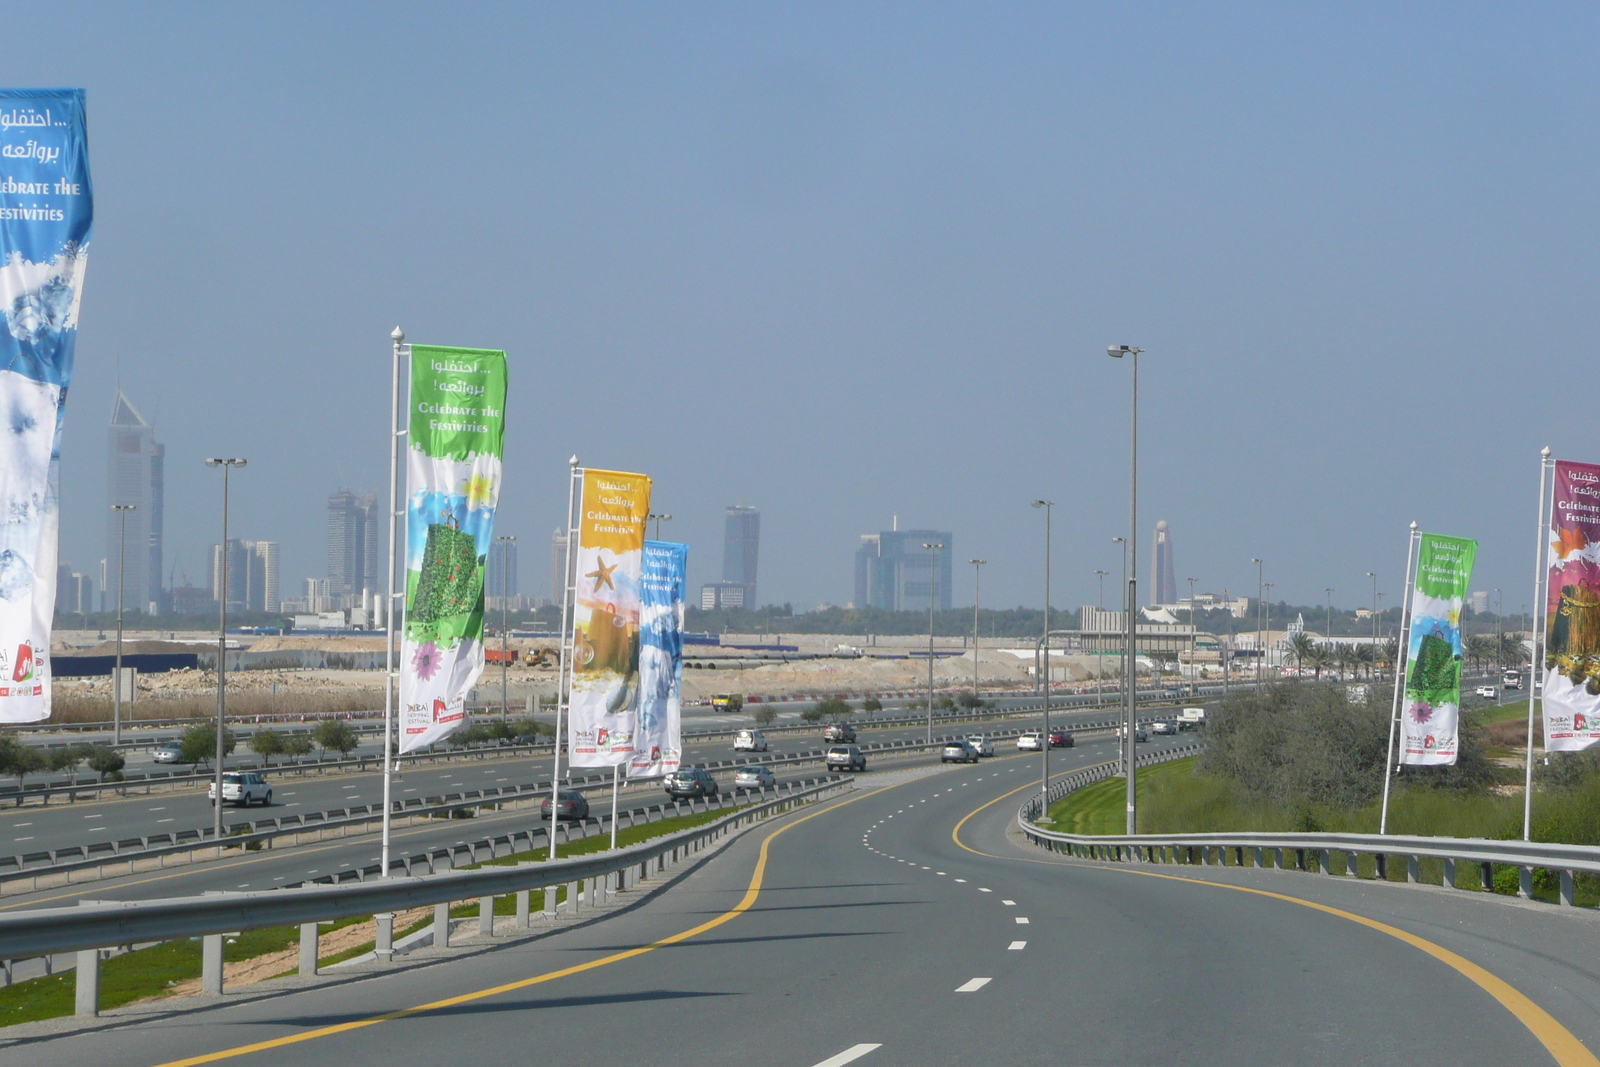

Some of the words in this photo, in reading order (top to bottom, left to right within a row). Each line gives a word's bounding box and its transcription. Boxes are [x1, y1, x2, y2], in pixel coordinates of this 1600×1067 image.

[418, 402, 477, 416] Celebrate
[481, 405, 500, 418] the
[429, 419, 489, 434] Festivities
[587, 510, 629, 522] Celebrate
[10, 686, 33, 697] 2009
